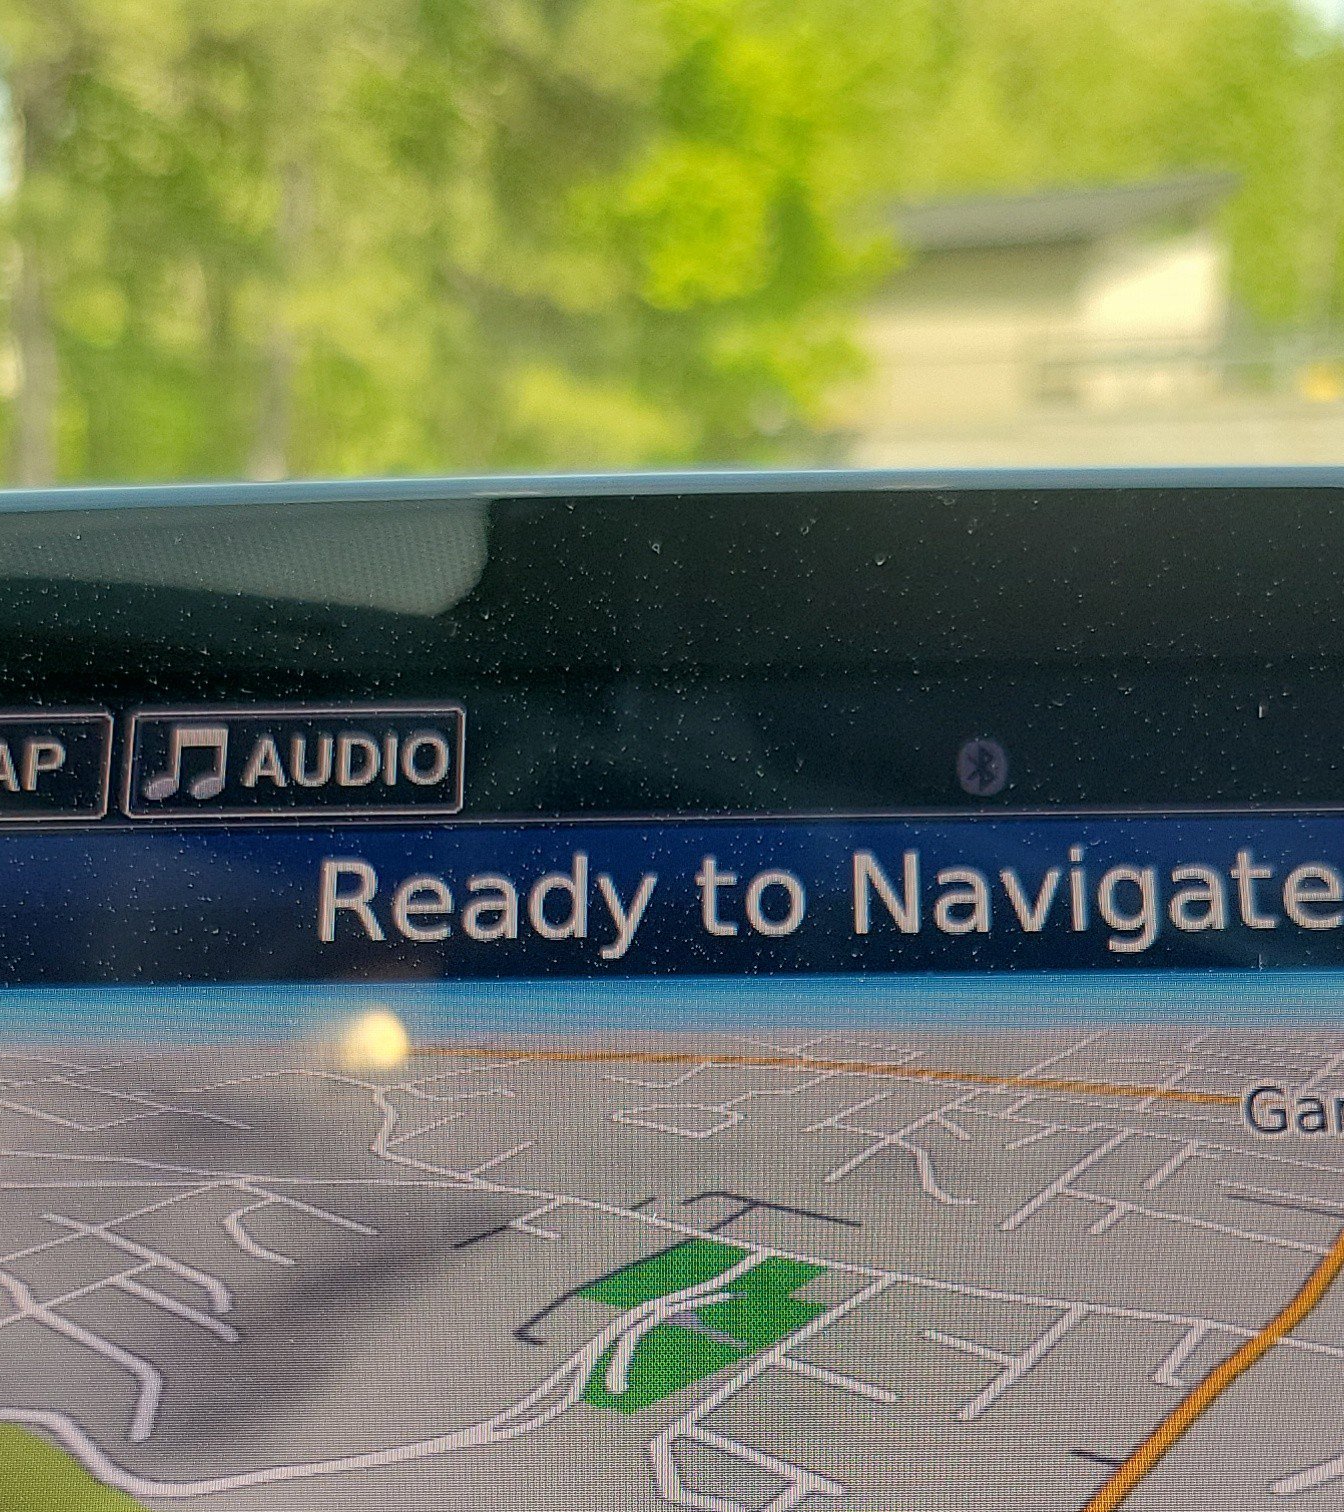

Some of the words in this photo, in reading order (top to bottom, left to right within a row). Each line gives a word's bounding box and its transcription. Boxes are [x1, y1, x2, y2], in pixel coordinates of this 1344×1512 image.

[241, 732, 452, 789] AUDIO
[317, 850, 659, 962] Ready
[695, 856, 807, 938] to
